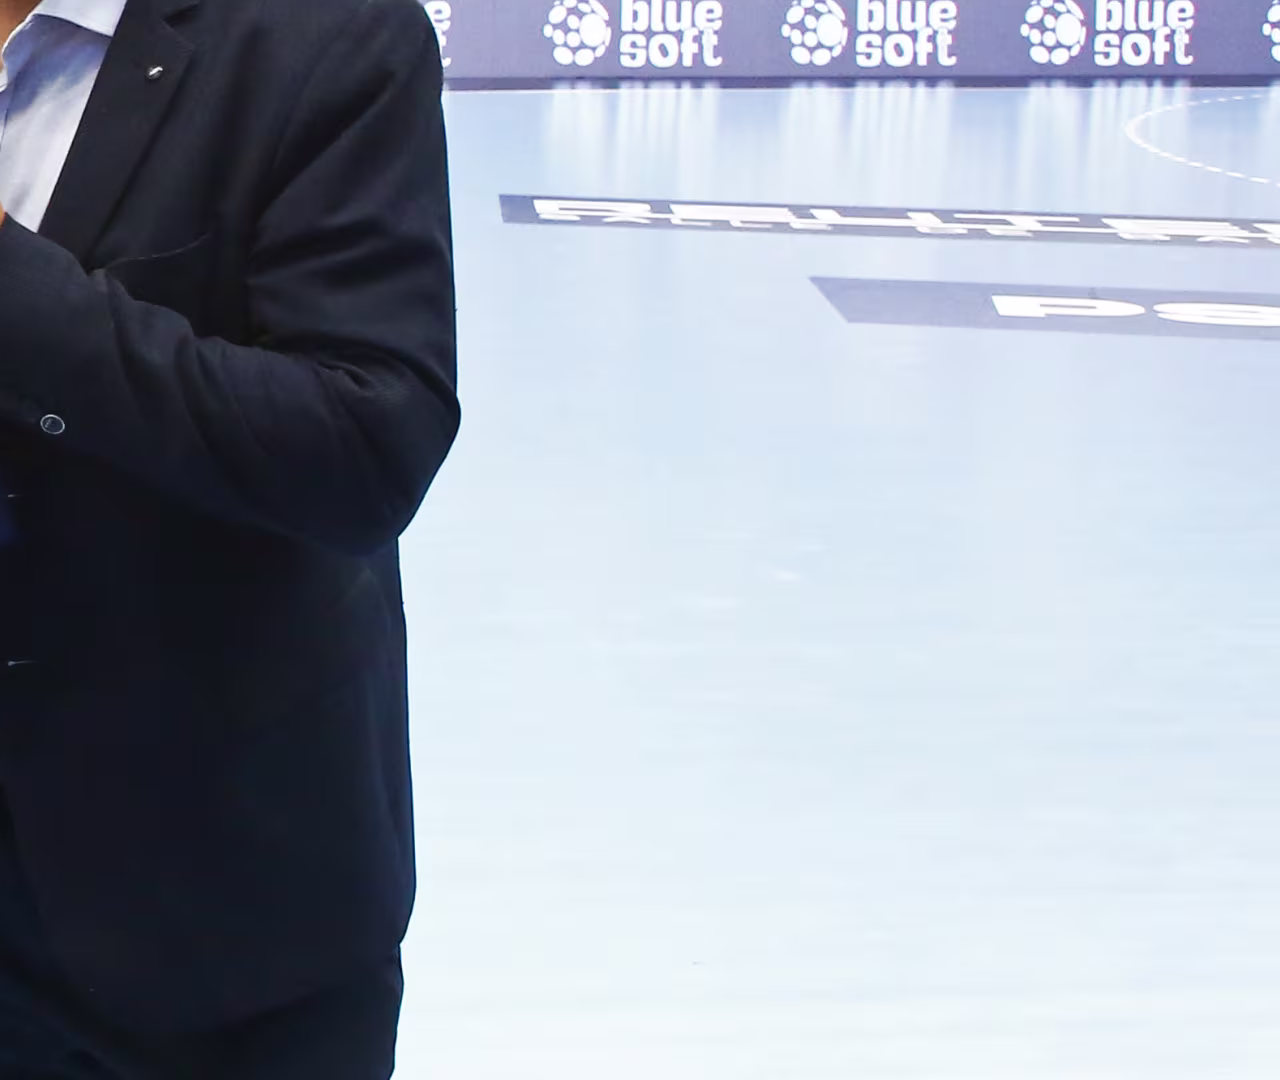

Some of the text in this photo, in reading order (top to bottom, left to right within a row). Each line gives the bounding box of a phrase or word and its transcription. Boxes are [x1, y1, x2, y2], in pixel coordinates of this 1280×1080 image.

[619, 28, 723, 68] soft
[855, 28, 958, 67] soft
[1093, 28, 1195, 67] soft
